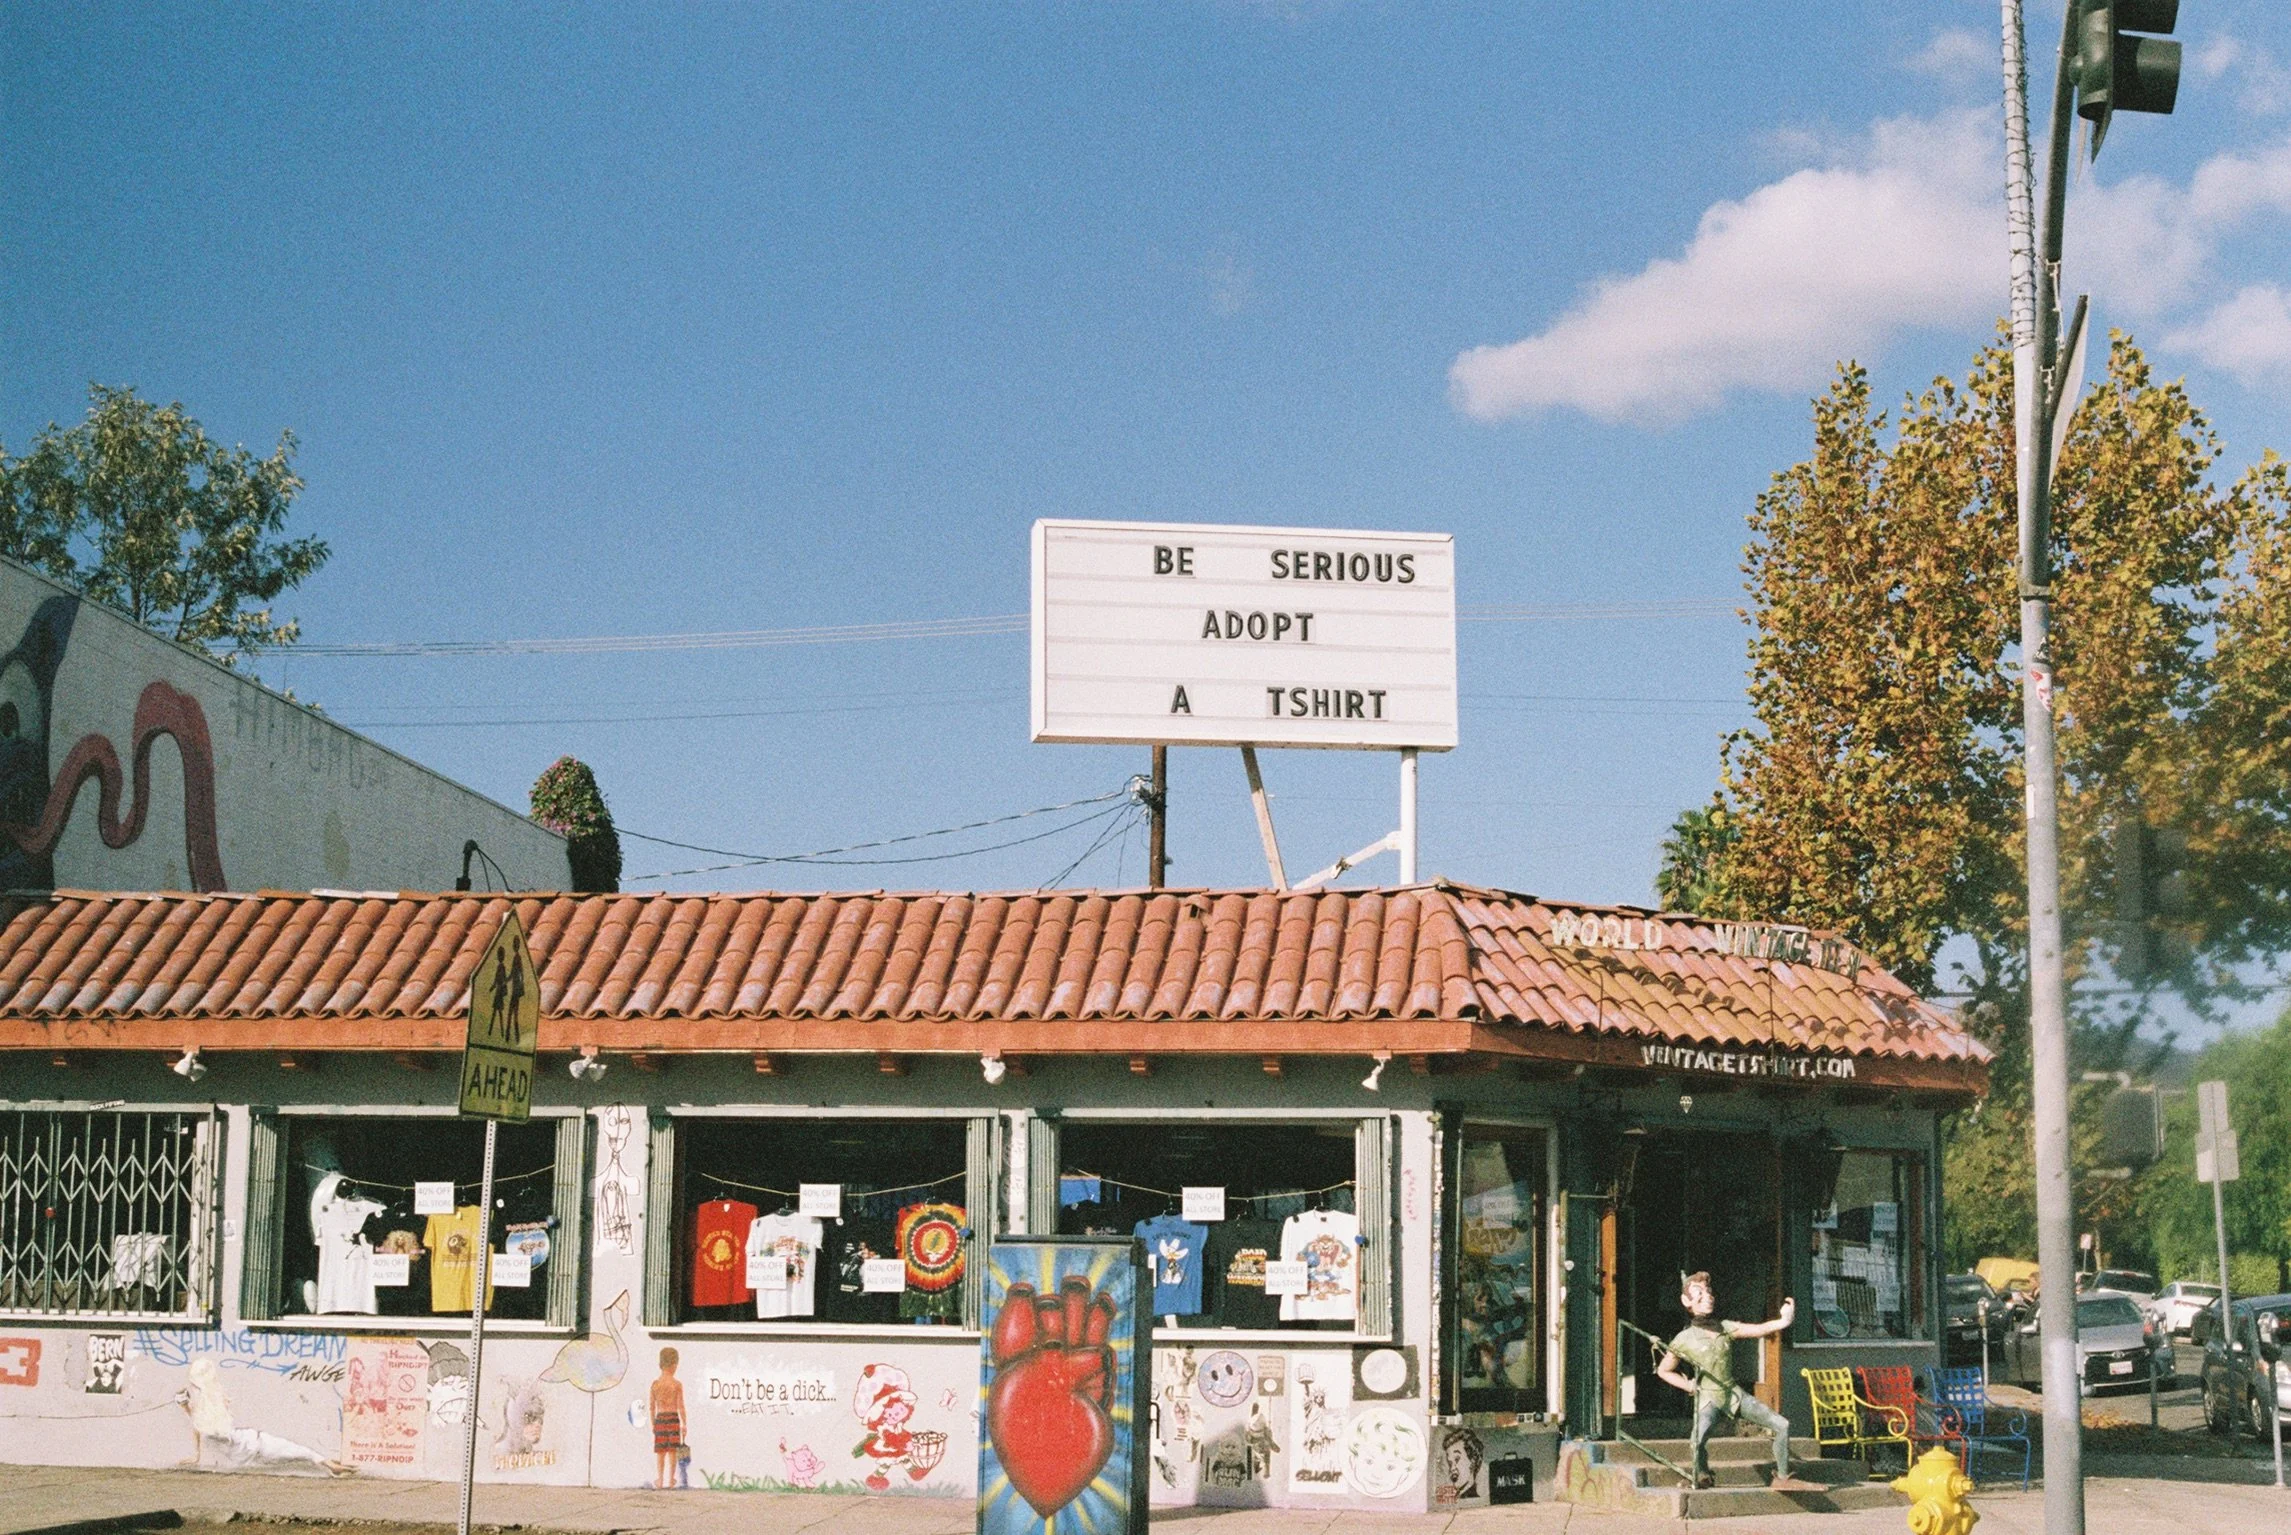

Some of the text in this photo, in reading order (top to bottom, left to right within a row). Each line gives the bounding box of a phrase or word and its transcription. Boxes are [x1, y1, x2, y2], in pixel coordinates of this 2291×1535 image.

[1153, 546, 1416, 584] BE SERIOUS
[1201, 610, 1314, 642] ADOPT
[1170, 685, 1387, 719] A TSHIRT
[1551, 916, 1662, 951] WORLD
[1714, 923, 1812, 966] VINTAGE
[468, 1062, 528, 1101] AHEAD
[417, 1187, 451, 1196] 40% OFF
[1185, 1192, 1221, 1200] 40% OFF
[373, 1259, 406, 1267] 40% OFF
[495, 1259, 529, 1267] 40% OFF
[748, 1261, 784, 1269] 40% OFF
[866, 1264, 903, 1272] 40% OFF
[1268, 1266, 1304, 1274] 40% OFF
[89, 1335, 125, 1362] BERN
[709, 1378, 837, 1402] Don't be a dick...
[1497, 1474, 1526, 1488] MASK
